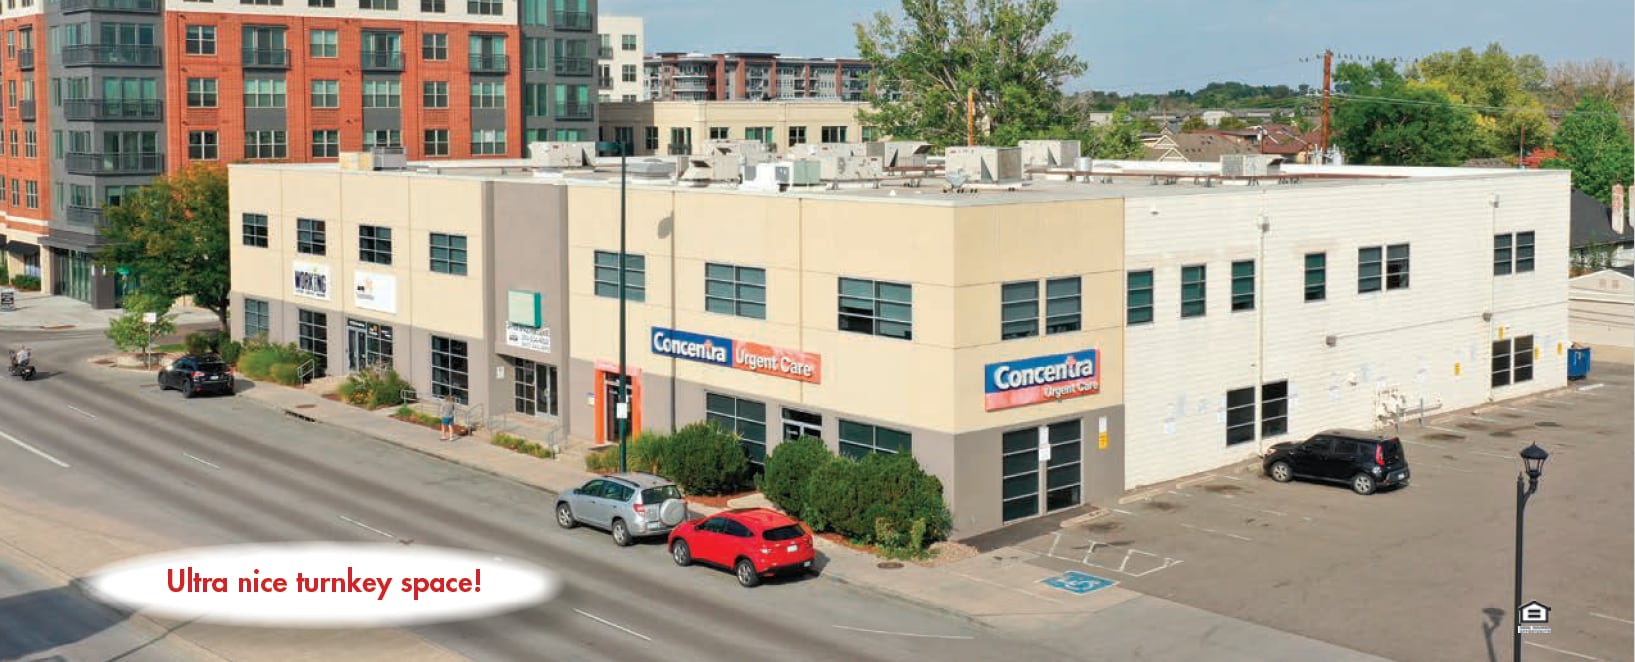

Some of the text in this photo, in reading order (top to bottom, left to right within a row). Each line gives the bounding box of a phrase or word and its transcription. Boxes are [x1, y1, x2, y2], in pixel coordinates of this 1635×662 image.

[653, 332, 813, 377] Concentra Urgent Care
[993, 355, 1094, 390] Concentra
[1045, 381, 1100, 398] Urgent Care
